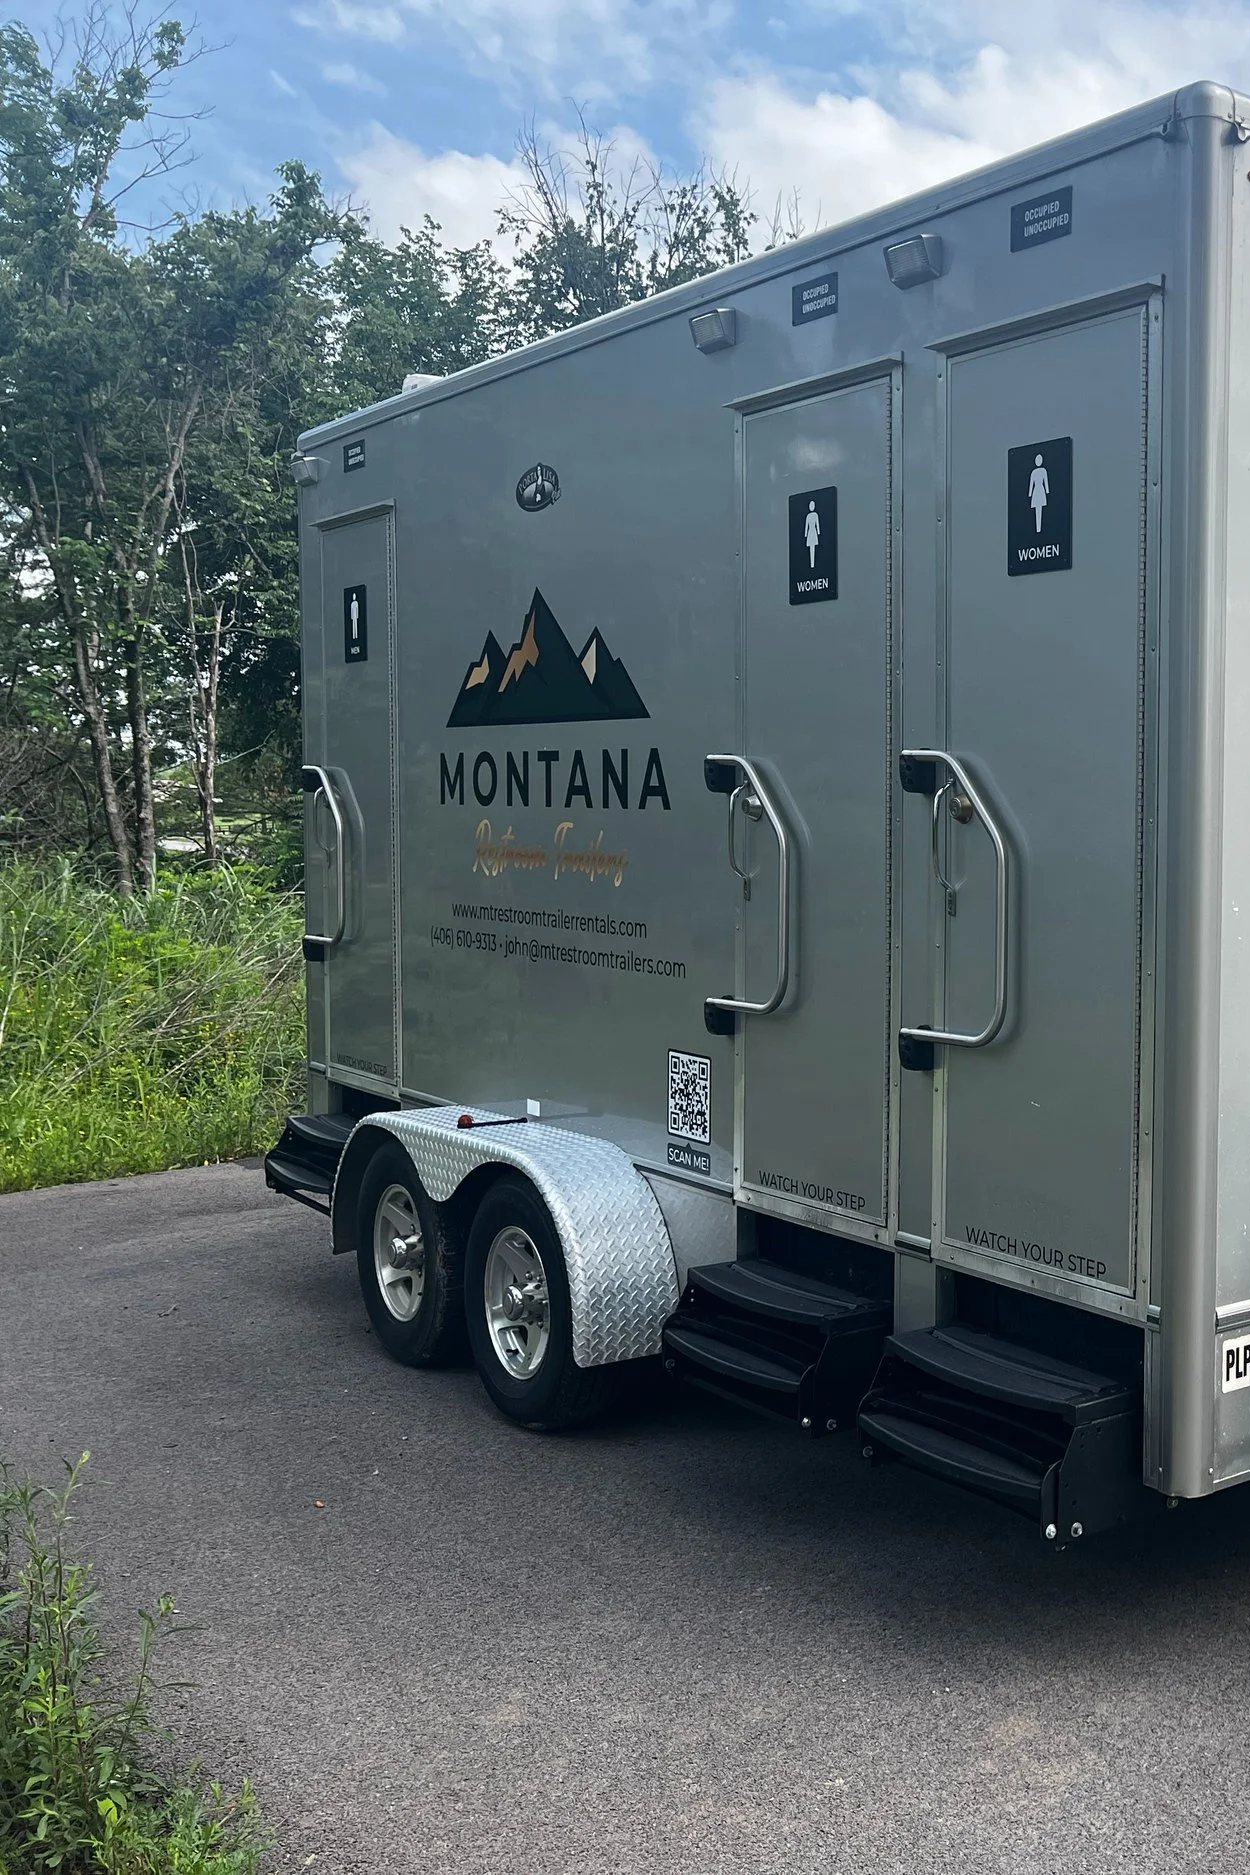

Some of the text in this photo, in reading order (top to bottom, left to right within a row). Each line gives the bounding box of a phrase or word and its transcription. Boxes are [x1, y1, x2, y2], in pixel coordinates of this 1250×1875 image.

[1024, 200, 1060, 222] OCCUPIED
[1023, 213, 1069, 238] UNOCCUPIED
[802, 283, 829, 301] OCCUPIED
[802, 294, 836, 314] UNOCCUPIED
[1018, 544, 1060, 561] WOMEN
[796, 578, 829, 593] WOMEN
[439, 747, 672, 811] MONTANA
[451, 903, 648, 939] www.mtrestroomtrailerrentals.com
[430, 925, 687, 979] (406) 610-9313 john@mtrestroomtrailers.com
[668, 1147, 710, 1172] SCAN ME!
[758, 1169, 866, 1211] WATCH YOUR STEP
[966, 1225, 1107, 1279] WATCH YOUR STEP
